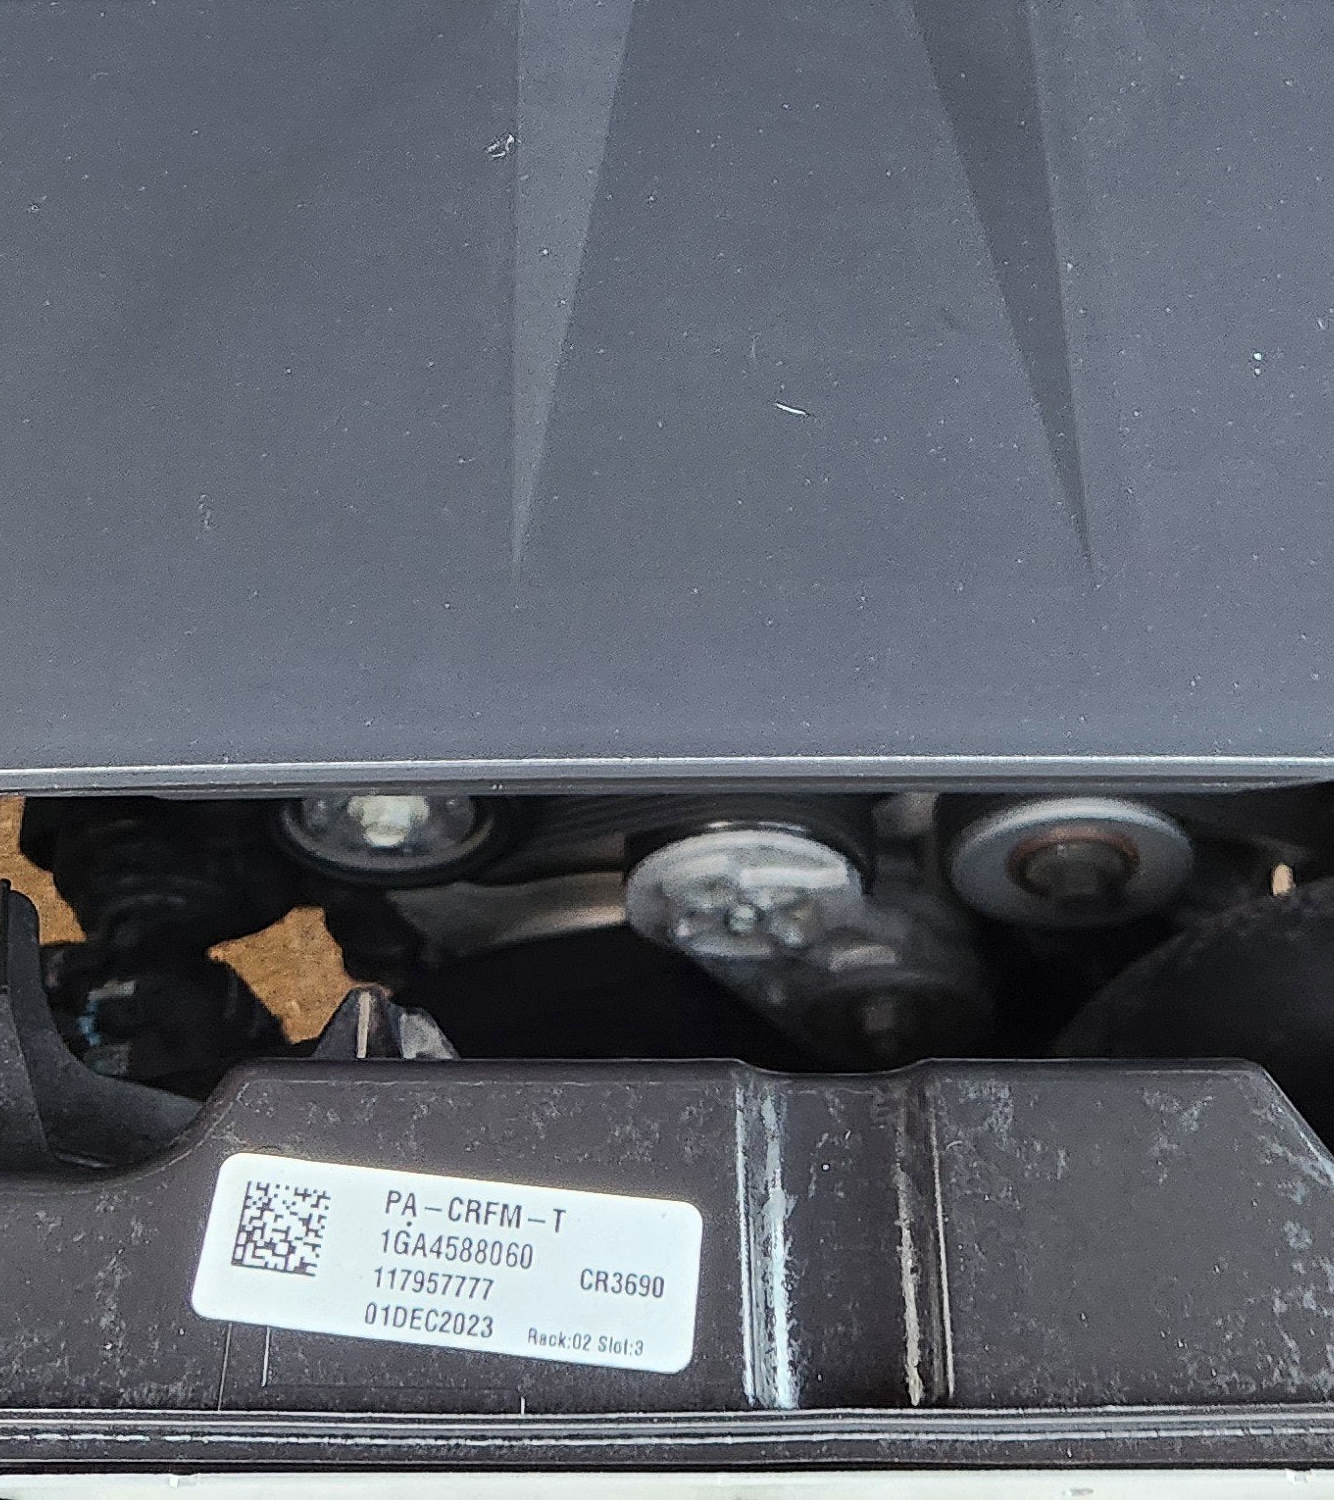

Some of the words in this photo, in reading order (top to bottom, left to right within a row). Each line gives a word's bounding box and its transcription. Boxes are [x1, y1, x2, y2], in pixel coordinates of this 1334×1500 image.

[380, 1228, 534, 1270] 1GA4588060
[373, 1265, 495, 1301] 117957777
[579, 1267, 665, 1299] CR3690
[364, 1301, 494, 1339] 01DEC2023
[528, 1327, 592, 1352] Rack:02
[597, 1335, 645, 1357] Slot:3
